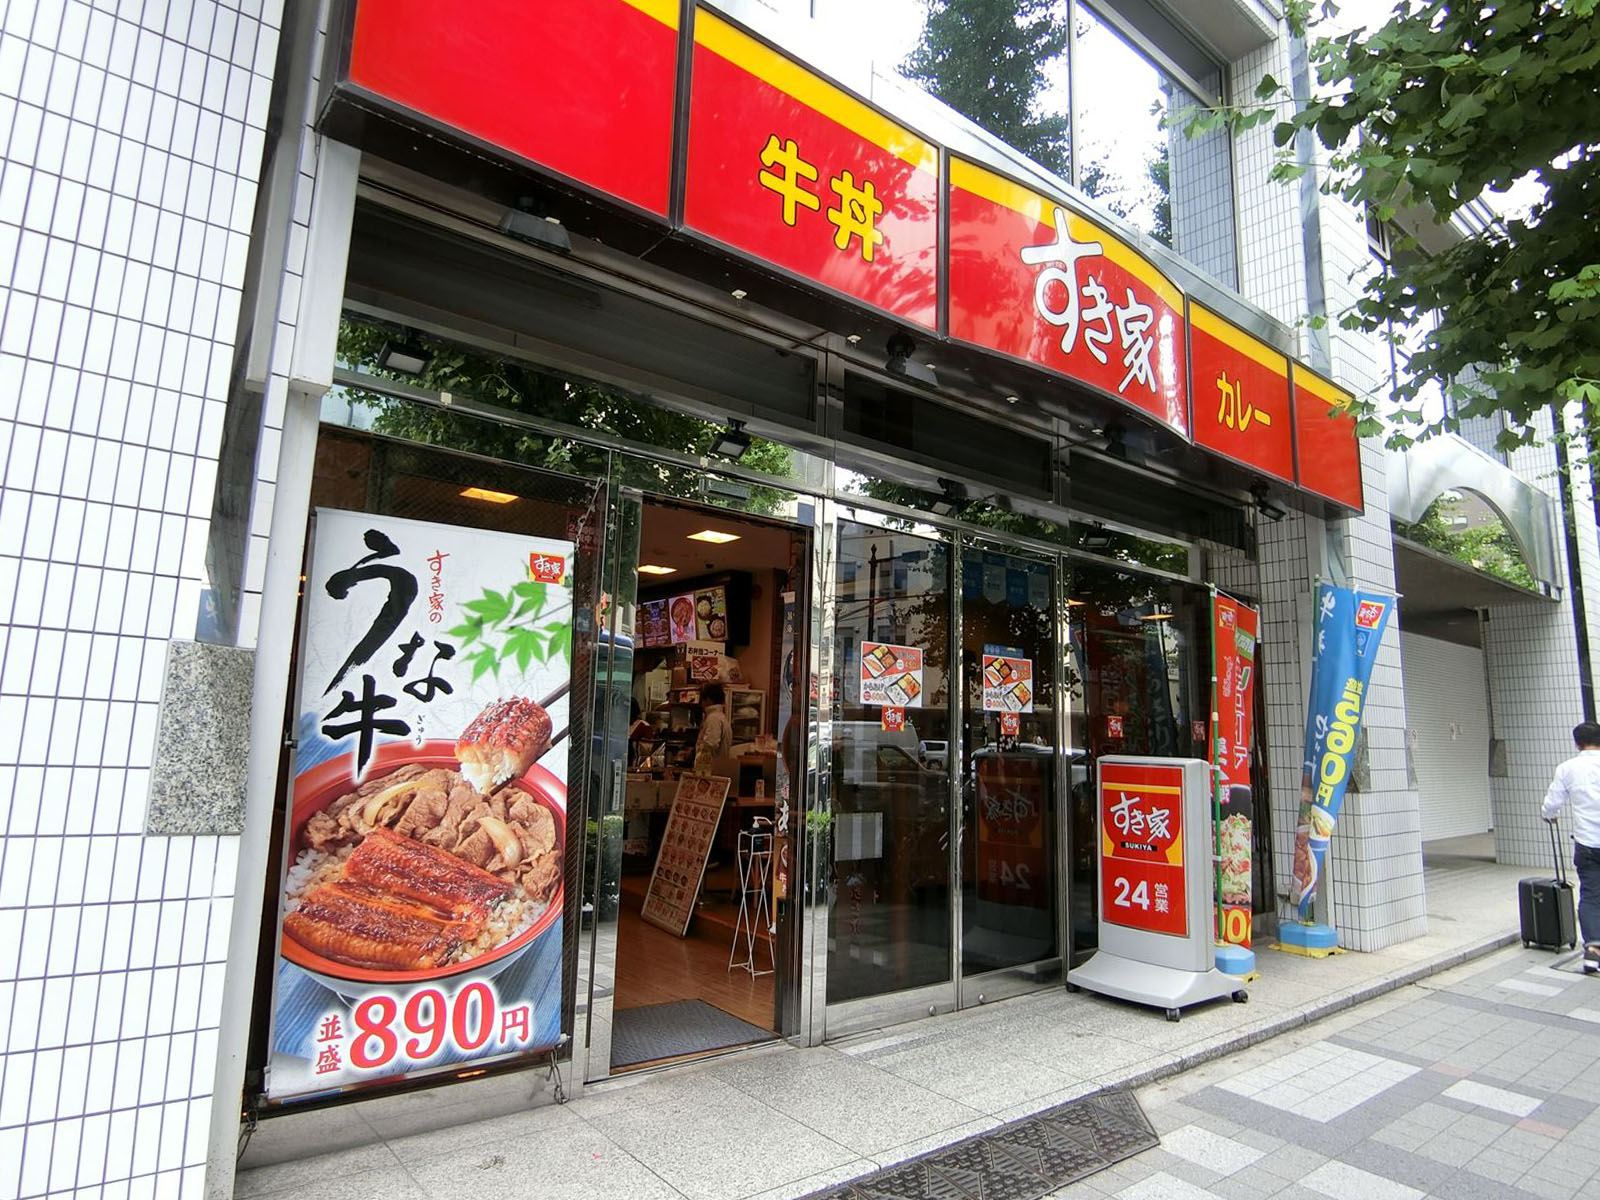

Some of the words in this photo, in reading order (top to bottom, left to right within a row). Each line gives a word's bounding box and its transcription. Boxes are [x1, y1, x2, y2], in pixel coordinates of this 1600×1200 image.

[759, 134, 883, 262] 牛丼
[1020, 207, 1157, 393] すき家
[1215, 371, 1272, 432] カレー
[427, 549, 450, 624] すき家の
[534, 555, 561, 576] すき家
[321, 528, 456, 780] うな牛
[1110, 792, 1171, 843] すき家
[1124, 841, 1153, 851] SUKIYA
[1114, 877, 1150, 911] 24
[1154, 883, 1169, 914] 営業
[316, 1015, 345, 1075] 並盛
[349, 982, 531, 1070] 890円
